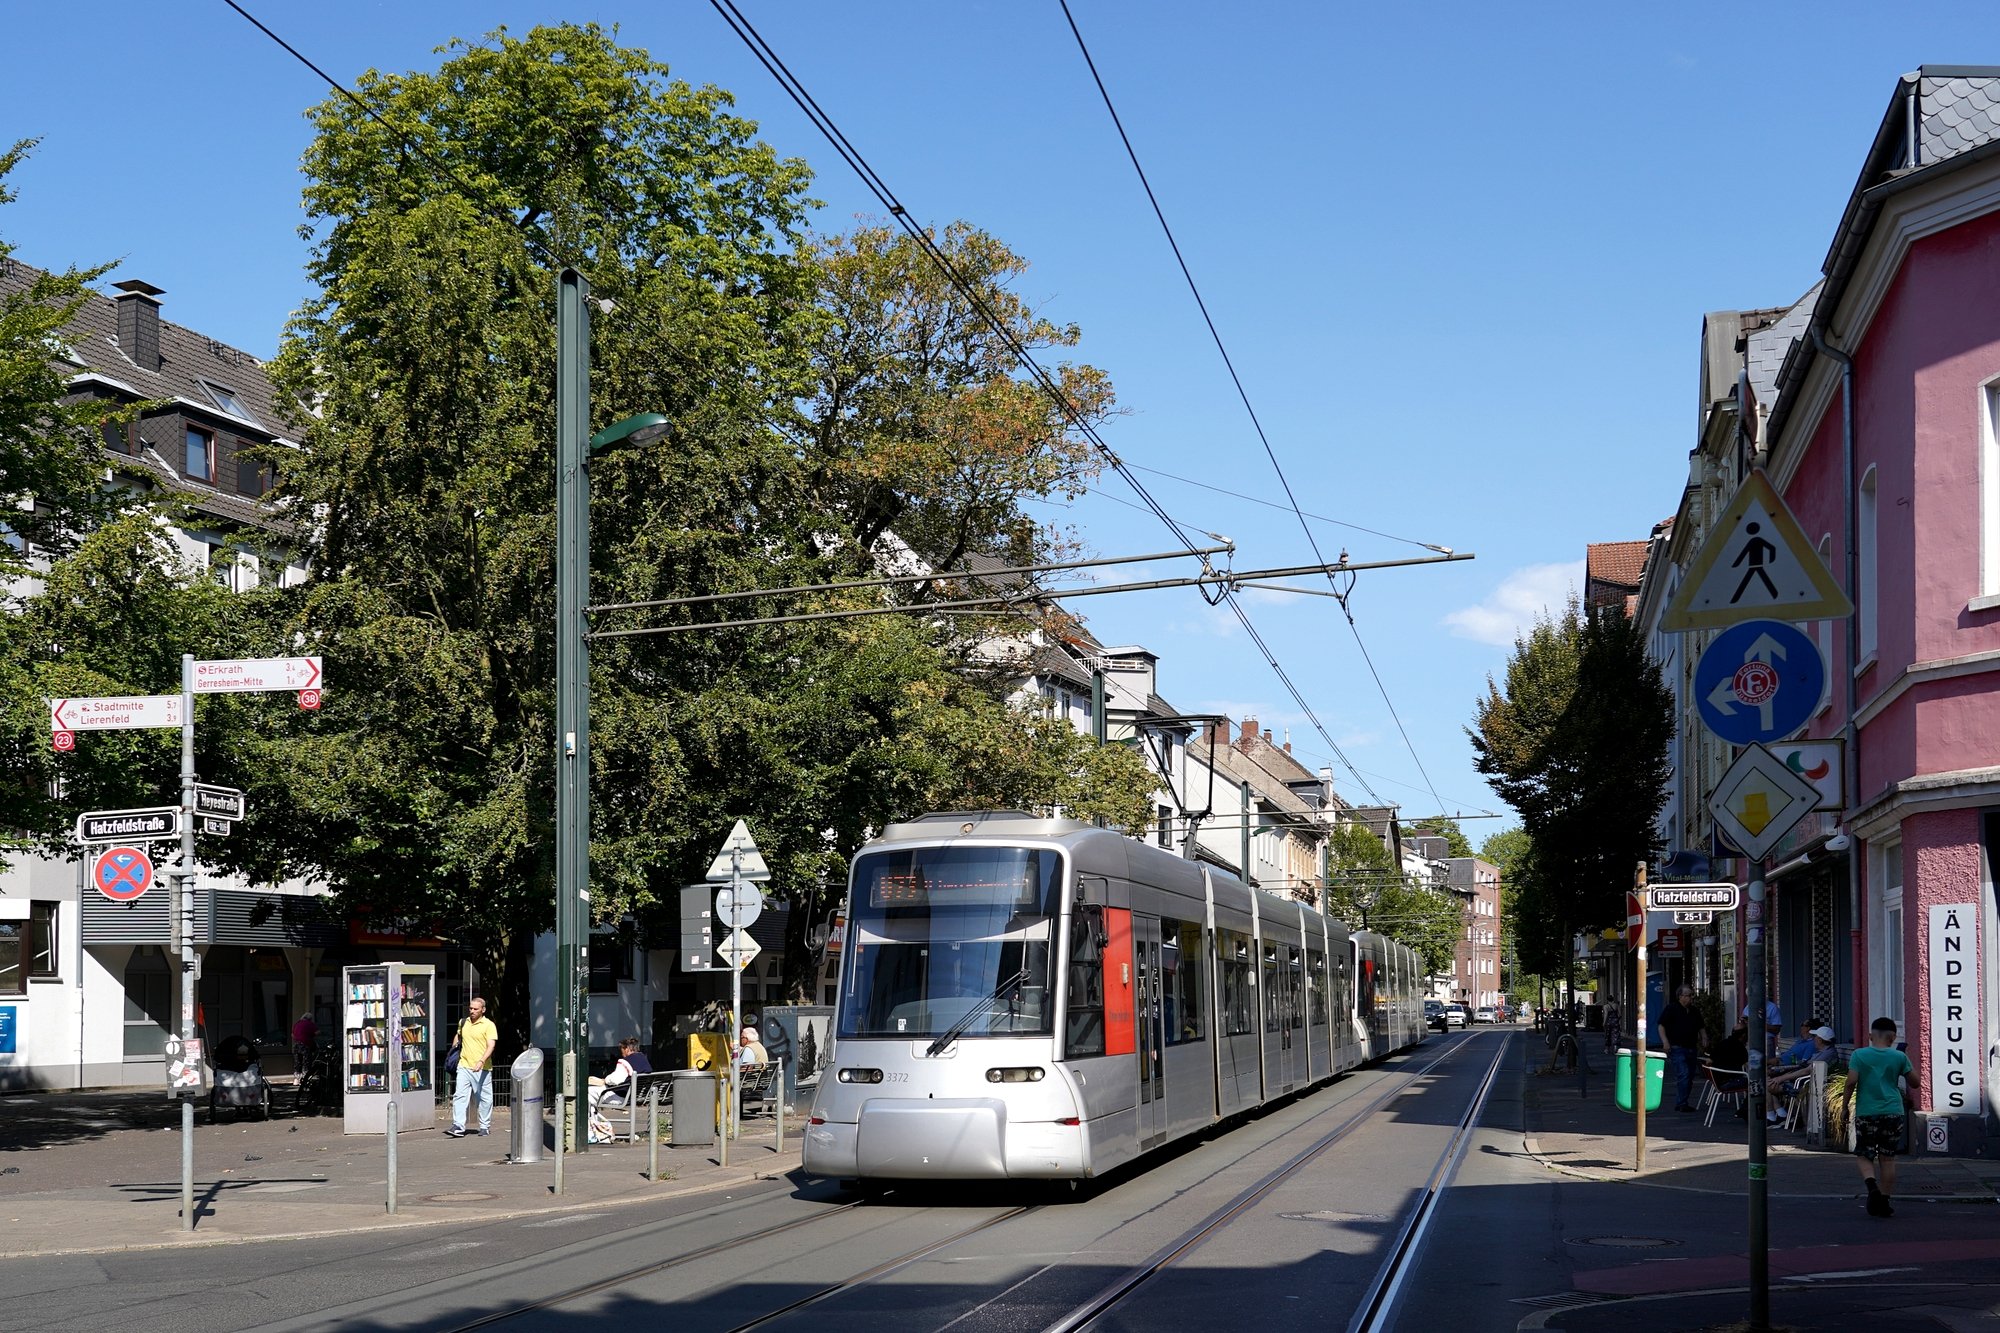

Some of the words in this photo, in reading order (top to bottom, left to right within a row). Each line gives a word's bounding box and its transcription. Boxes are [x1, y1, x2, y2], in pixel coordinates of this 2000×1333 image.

[208, 665, 243, 675] Erkrath
[198, 679, 263, 688] Gerresheim-Mitte
[304, 694, 315, 703] 38
[94, 702, 144, 712] Stadtmitte
[80, 715, 130, 725] Lierenfeld
[58, 735, 69, 745] 23
[201, 793, 238, 812] Heyestraße
[90, 817, 165, 835] Hatzfeldstraße
[1657, 891, 1729, 903] Hatzfeldstraße
[1684, 913, 1702, 921] 25-1
[1944, 909, 1965, 1108] ÄNDERUNGS
[886, 1072, 910, 1083] 3372
